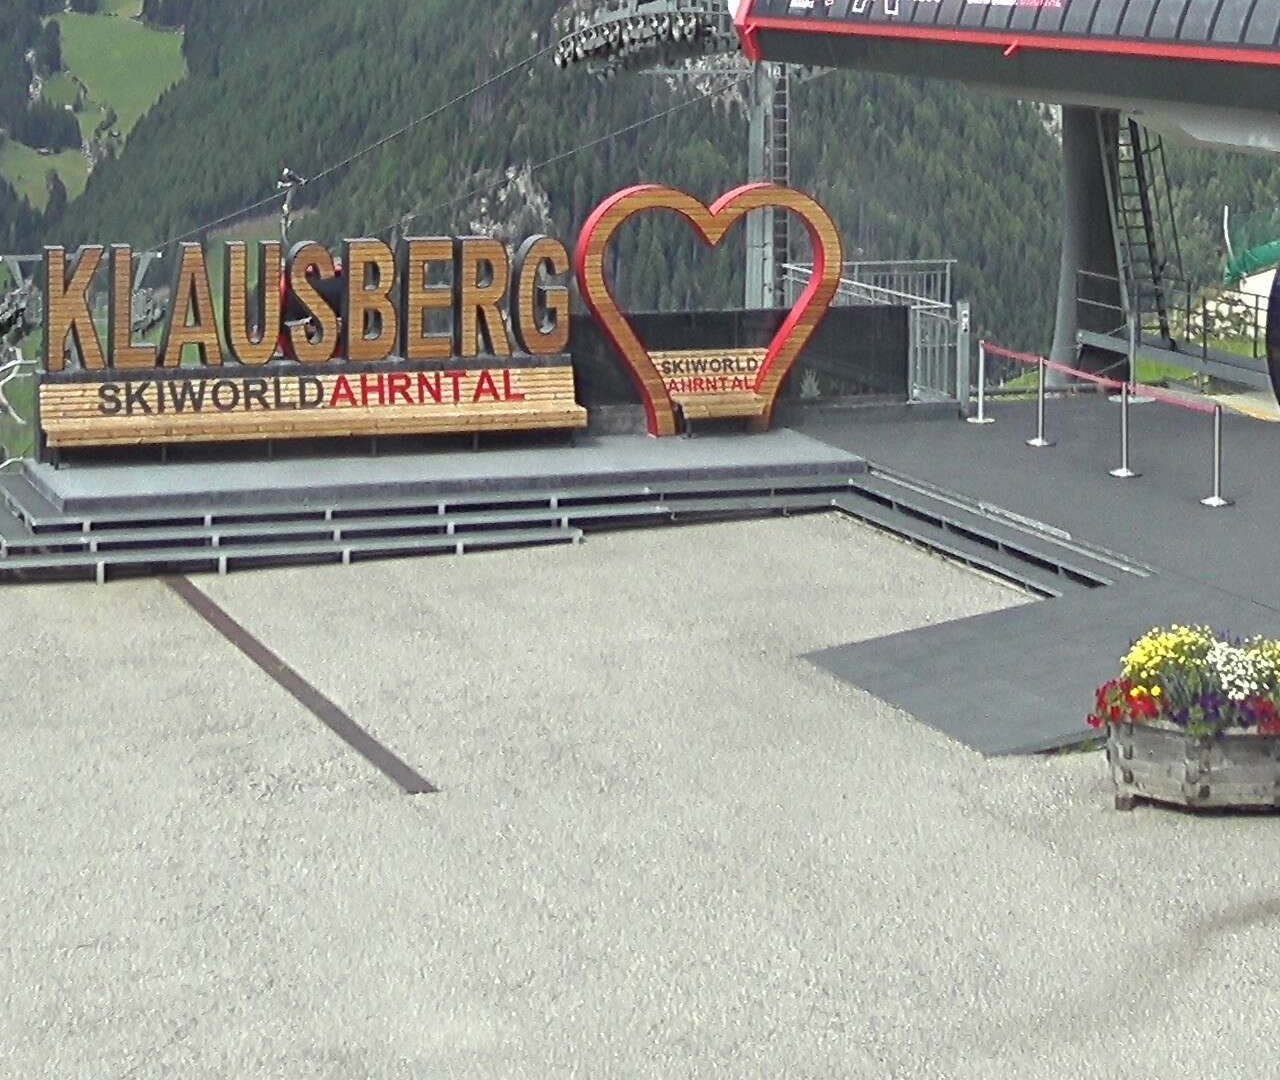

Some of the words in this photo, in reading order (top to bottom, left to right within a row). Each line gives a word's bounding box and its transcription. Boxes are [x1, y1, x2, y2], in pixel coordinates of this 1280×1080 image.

[43, 234, 570, 371] KLAUSBERG
[661, 358, 759, 374] SKIWORLD
[668, 376, 756, 392] AHRNTAL
